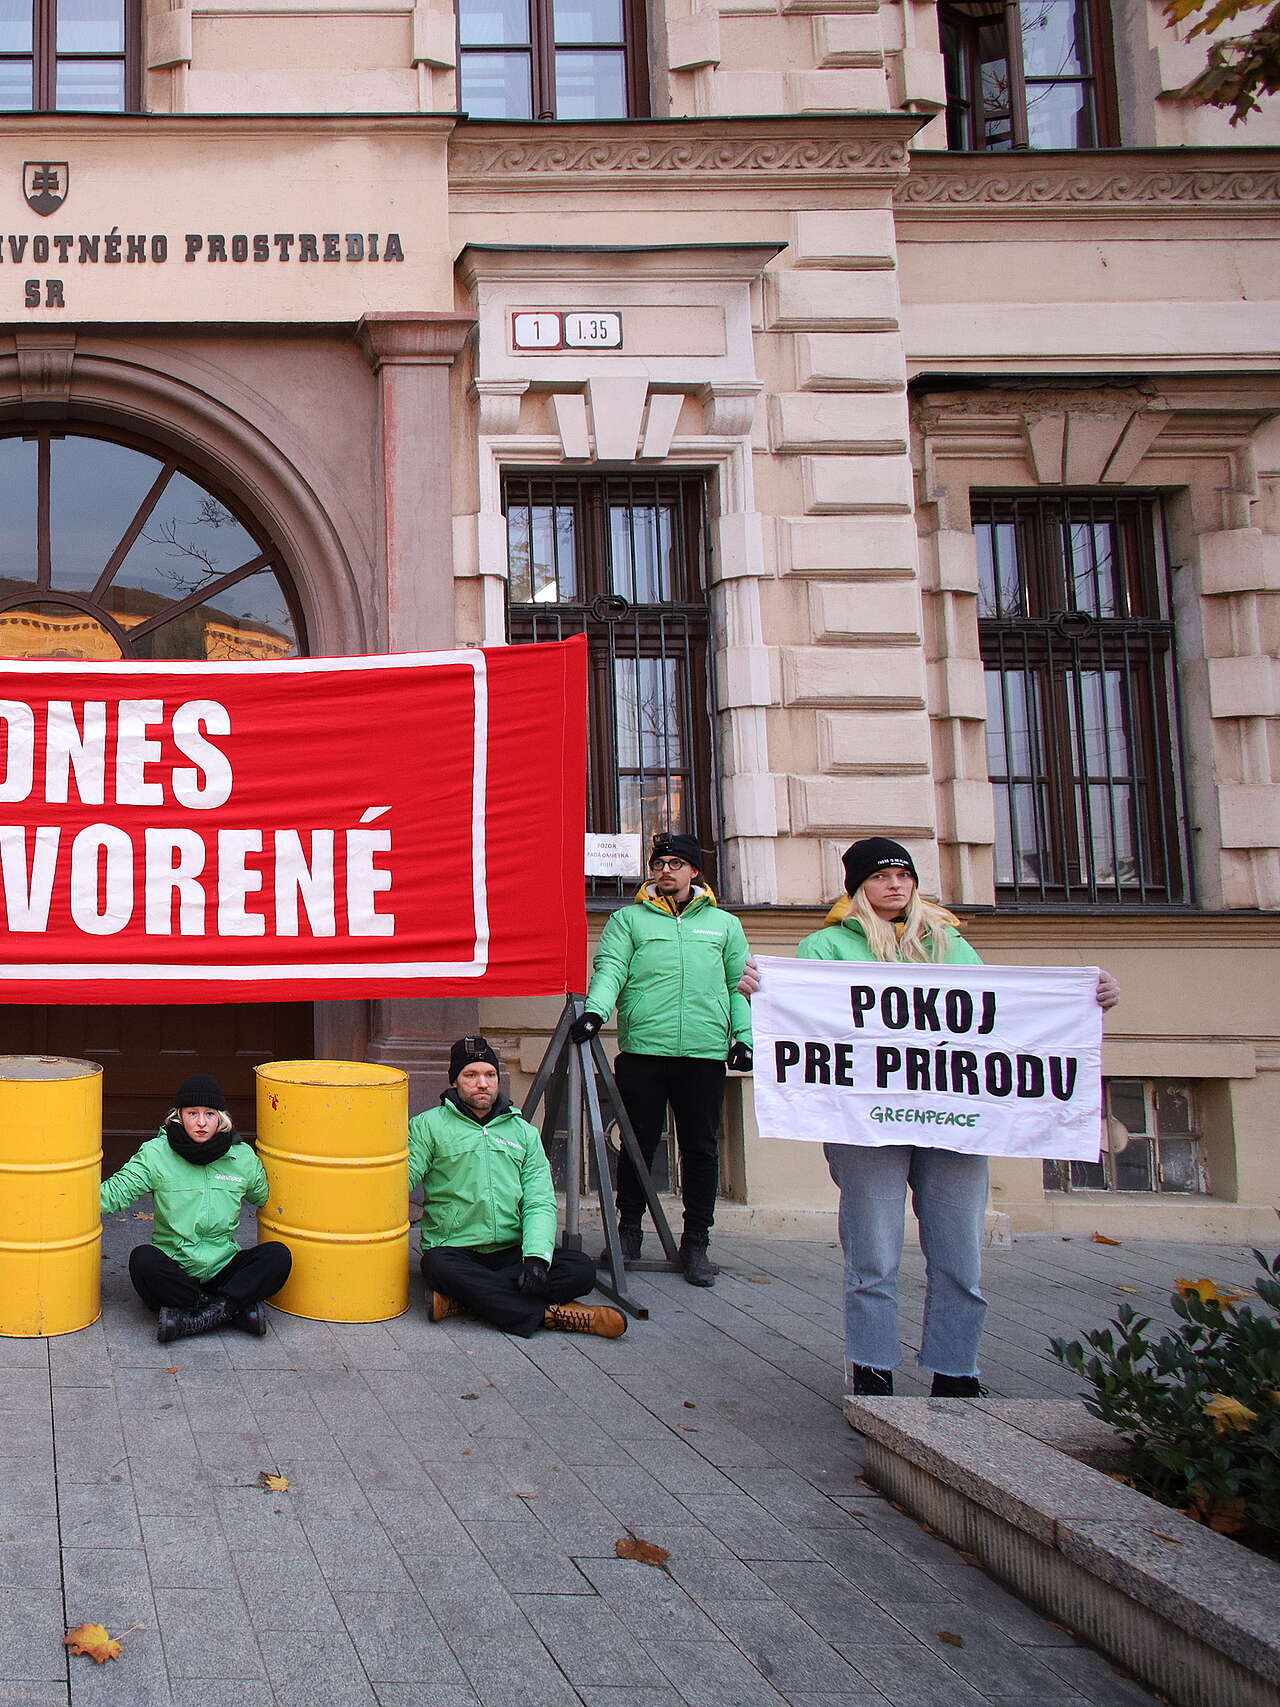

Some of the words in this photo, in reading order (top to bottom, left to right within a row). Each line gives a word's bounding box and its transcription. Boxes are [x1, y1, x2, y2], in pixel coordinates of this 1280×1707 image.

[184, 233, 405, 263] PROSTREDIA
[24, 279, 66, 309] SR
[532, 320, 541, 340] 1
[850, 985, 997, 1035] POKOJ
[774, 1040, 854, 1087] PRE
[876, 1039, 1078, 1102] PRÍRODU
[869, 1105, 982, 1128] GREENPEACE
